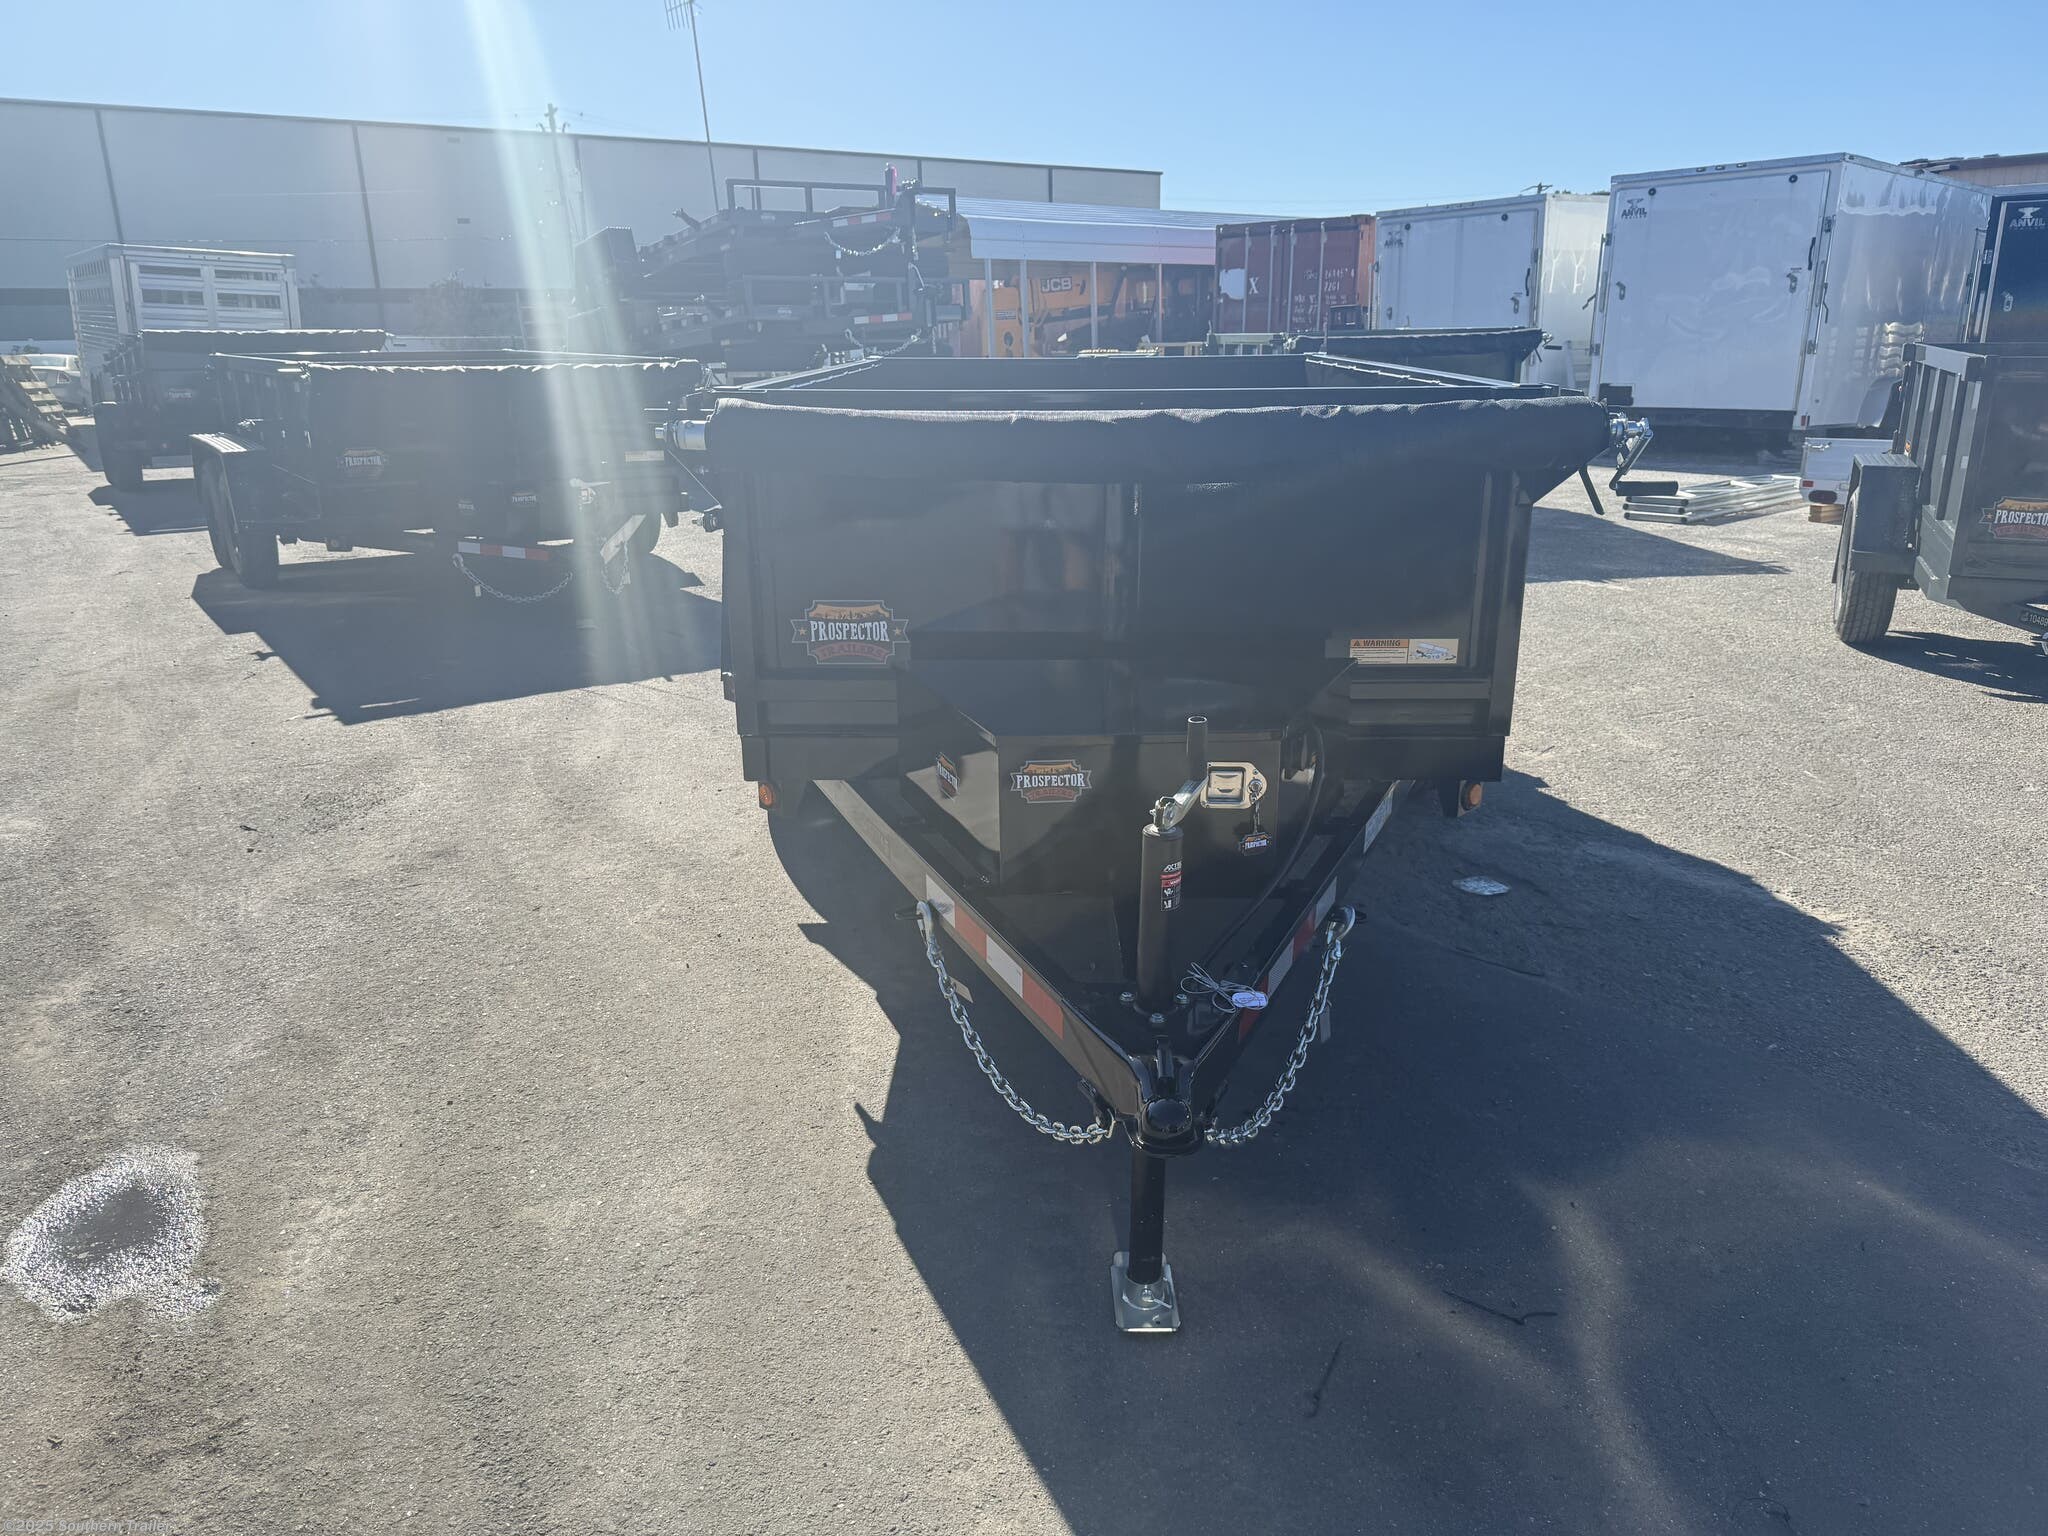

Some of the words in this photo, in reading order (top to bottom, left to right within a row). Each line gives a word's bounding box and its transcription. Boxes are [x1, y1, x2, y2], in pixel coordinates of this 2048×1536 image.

[2009, 217, 2046, 227] ANVIL
[1041, 277, 1072, 292] JCB
[1994, 509, 2048, 526] PROSPECTO
[810, 620, 890, 642] PROSPECTOR
[1016, 773, 1085, 788] PROSPECTOR
